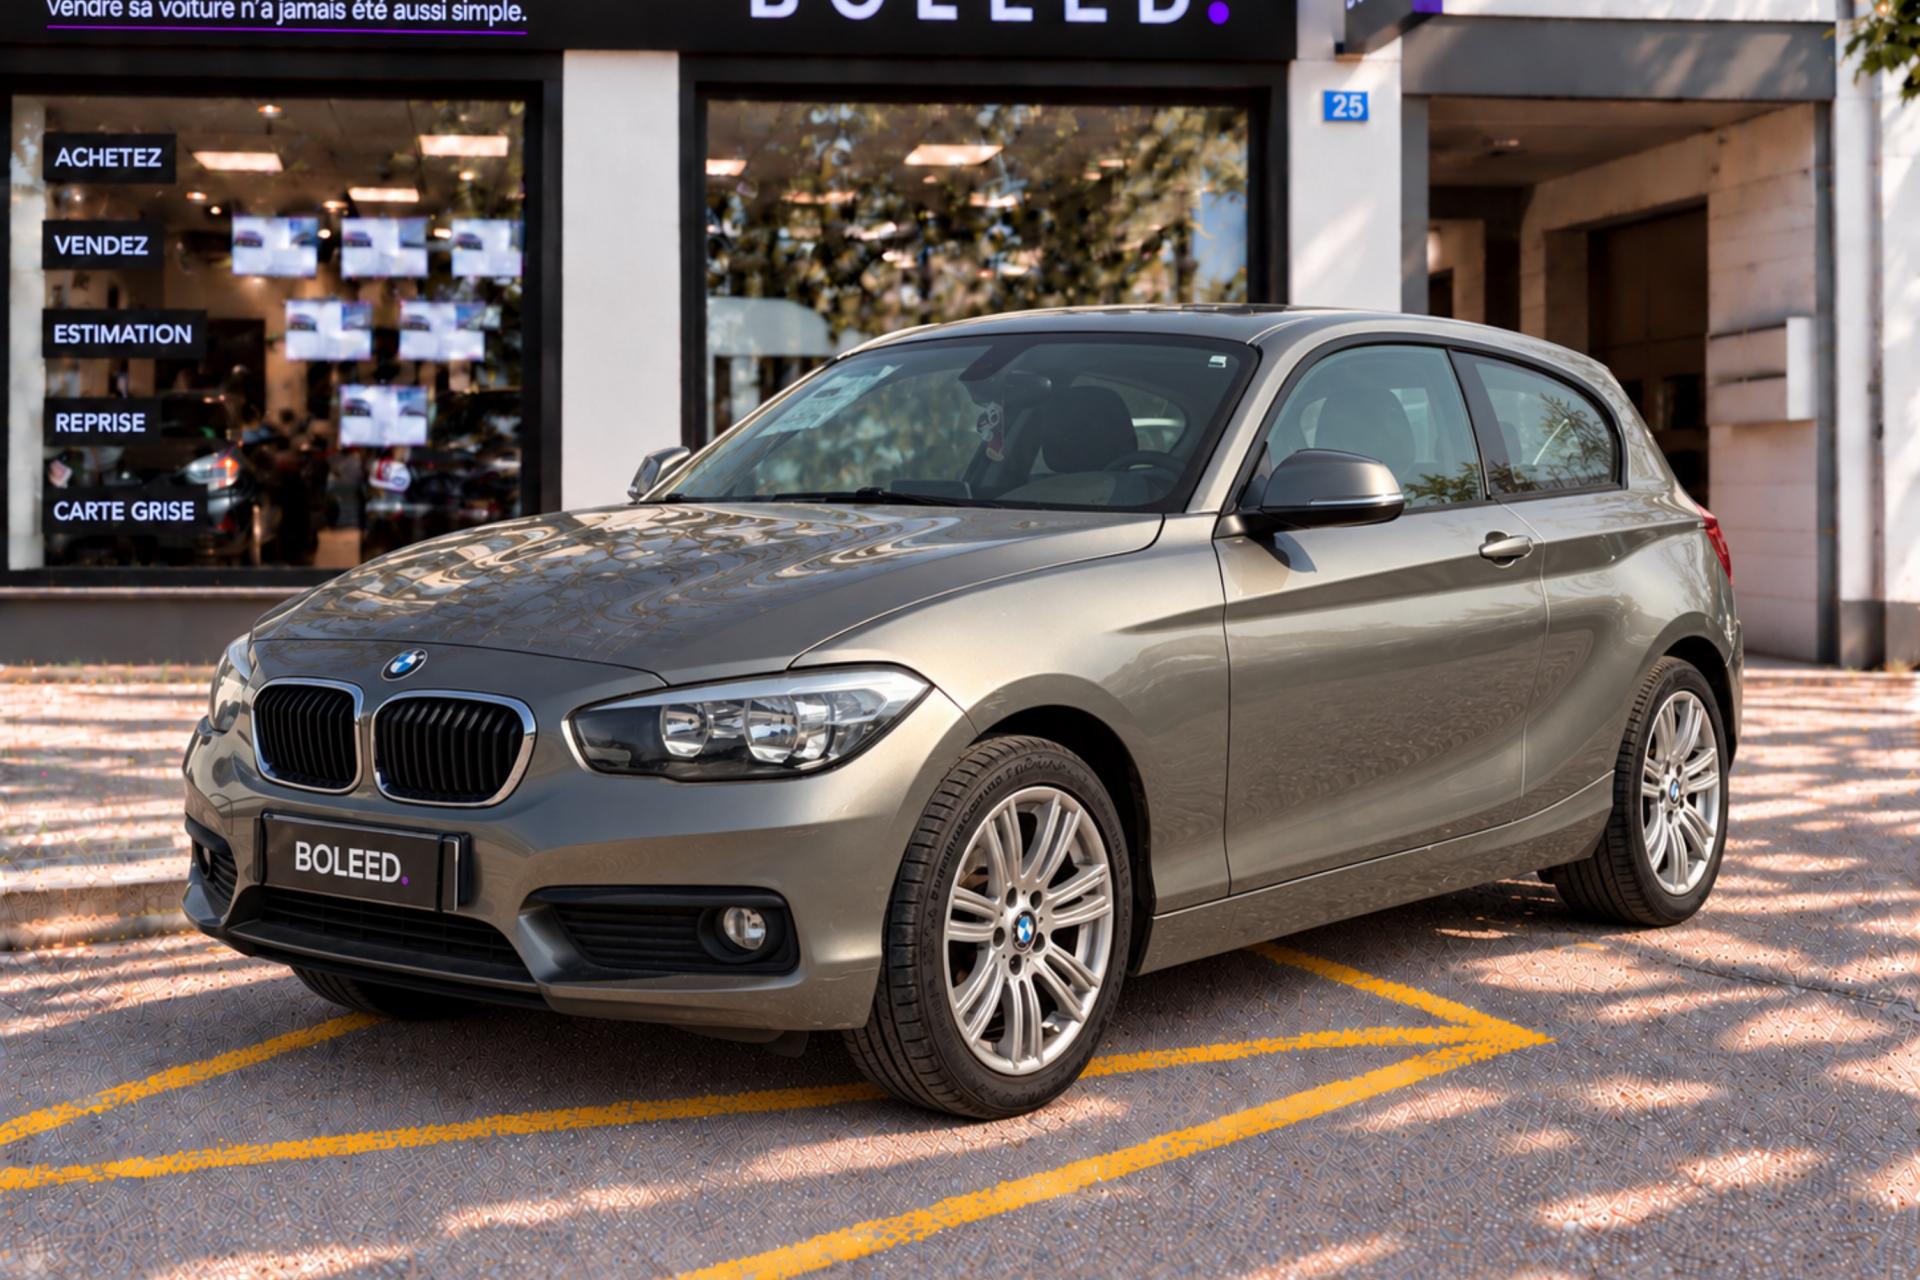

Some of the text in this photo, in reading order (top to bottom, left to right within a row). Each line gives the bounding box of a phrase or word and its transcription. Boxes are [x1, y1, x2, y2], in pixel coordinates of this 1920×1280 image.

[128, 0, 153, 18] sa
[158, 0, 236, 19] voiture
[276, 0, 347, 26] jamais
[351, 0, 388, 21] été
[393, 0, 447, 21] aussi
[451, 0, 528, 27] simple.
[1332, 94, 1365, 119] 25
[54, 147, 163, 168] ACHETEZ
[54, 235, 150, 256] VENDEZ
[53, 323, 193, 345] ESTIMATION
[54, 412, 147, 433] REPRISE
[53, 501, 195, 521] CARTE GRISE
[295, 840, 409, 886] BOLEED.
